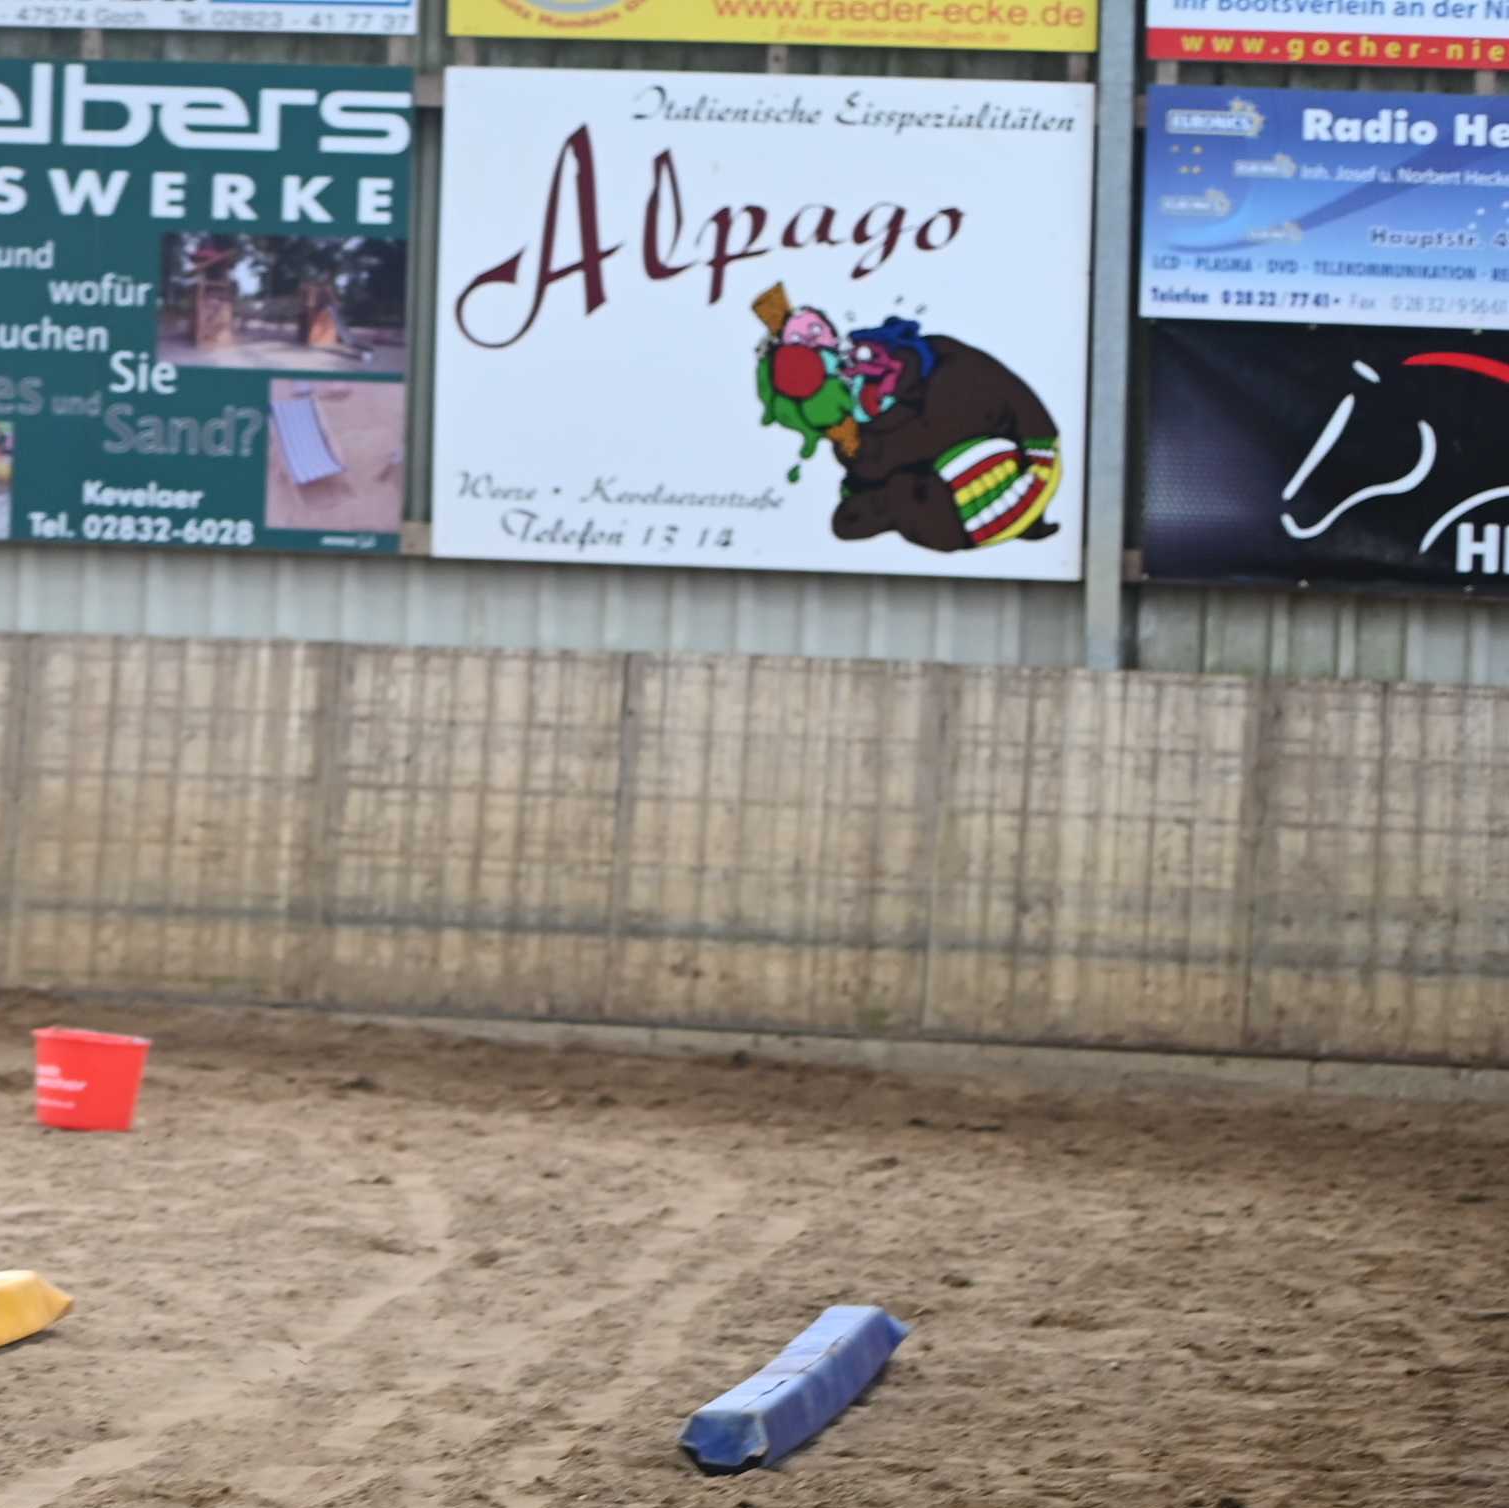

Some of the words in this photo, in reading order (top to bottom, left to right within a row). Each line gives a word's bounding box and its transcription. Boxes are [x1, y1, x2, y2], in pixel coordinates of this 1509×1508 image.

[712, 0, 1086, 27] www.raeder-ecke.de
[1217, 0, 1386, 16] Bootsverleih
[1392, 1, 1425, 17] an
[1433, 0, 1479, 18] der
[631, 84, 822, 127] Italienische
[834, 89, 1078, 135] Eisspezialitäten
[1302, 107, 1438, 145] Radio
[455, 123, 966, 348] Alpago
[48, 273, 153, 307] wofür
[108, 350, 178, 395] Sie
[50, 390, 103, 417] und
[102, 402, 264, 457] Sand?
[82, 479, 206, 510] Kevelaer
[27, 511, 75, 539] Tel.
[82, 513, 256, 547] 02832-6028
[500, 507, 624, 552] Telefon
